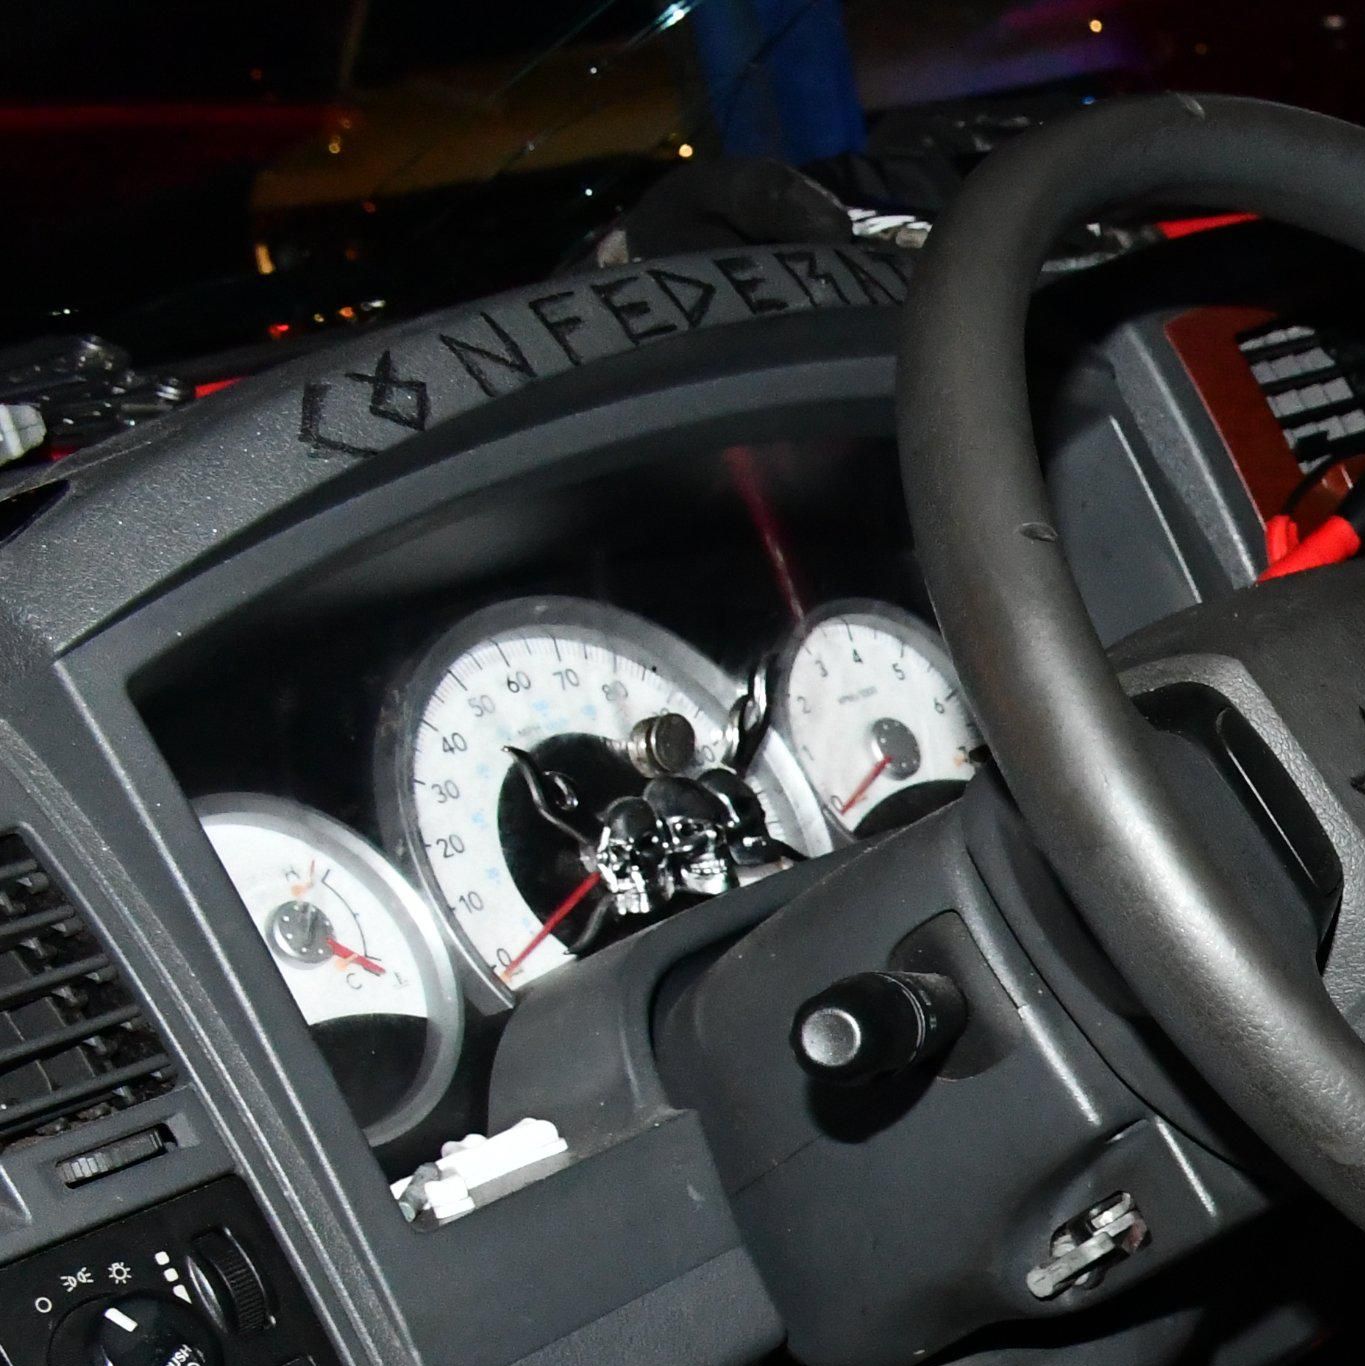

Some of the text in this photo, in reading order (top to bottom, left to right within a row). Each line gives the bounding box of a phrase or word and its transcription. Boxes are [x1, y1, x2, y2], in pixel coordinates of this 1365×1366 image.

[852, 649, 863, 664] 4
[553, 668, 580, 691] 70
[815, 659, 828, 678] 3
[892, 662, 905, 681] 5
[506, 670, 531, 694] 60
[602, 680, 629, 702] 80
[468, 694, 495, 718] 50
[797, 695, 811, 714] 2
[934, 697, 945, 715] 6
[441, 731, 468, 755] 40
[431, 779, 460, 804] 30
[436, 834, 465, 859] 20
[458, 891, 484, 914] 10
[496, 947, 512, 967] 0
[346, 972, 362, 990] C
